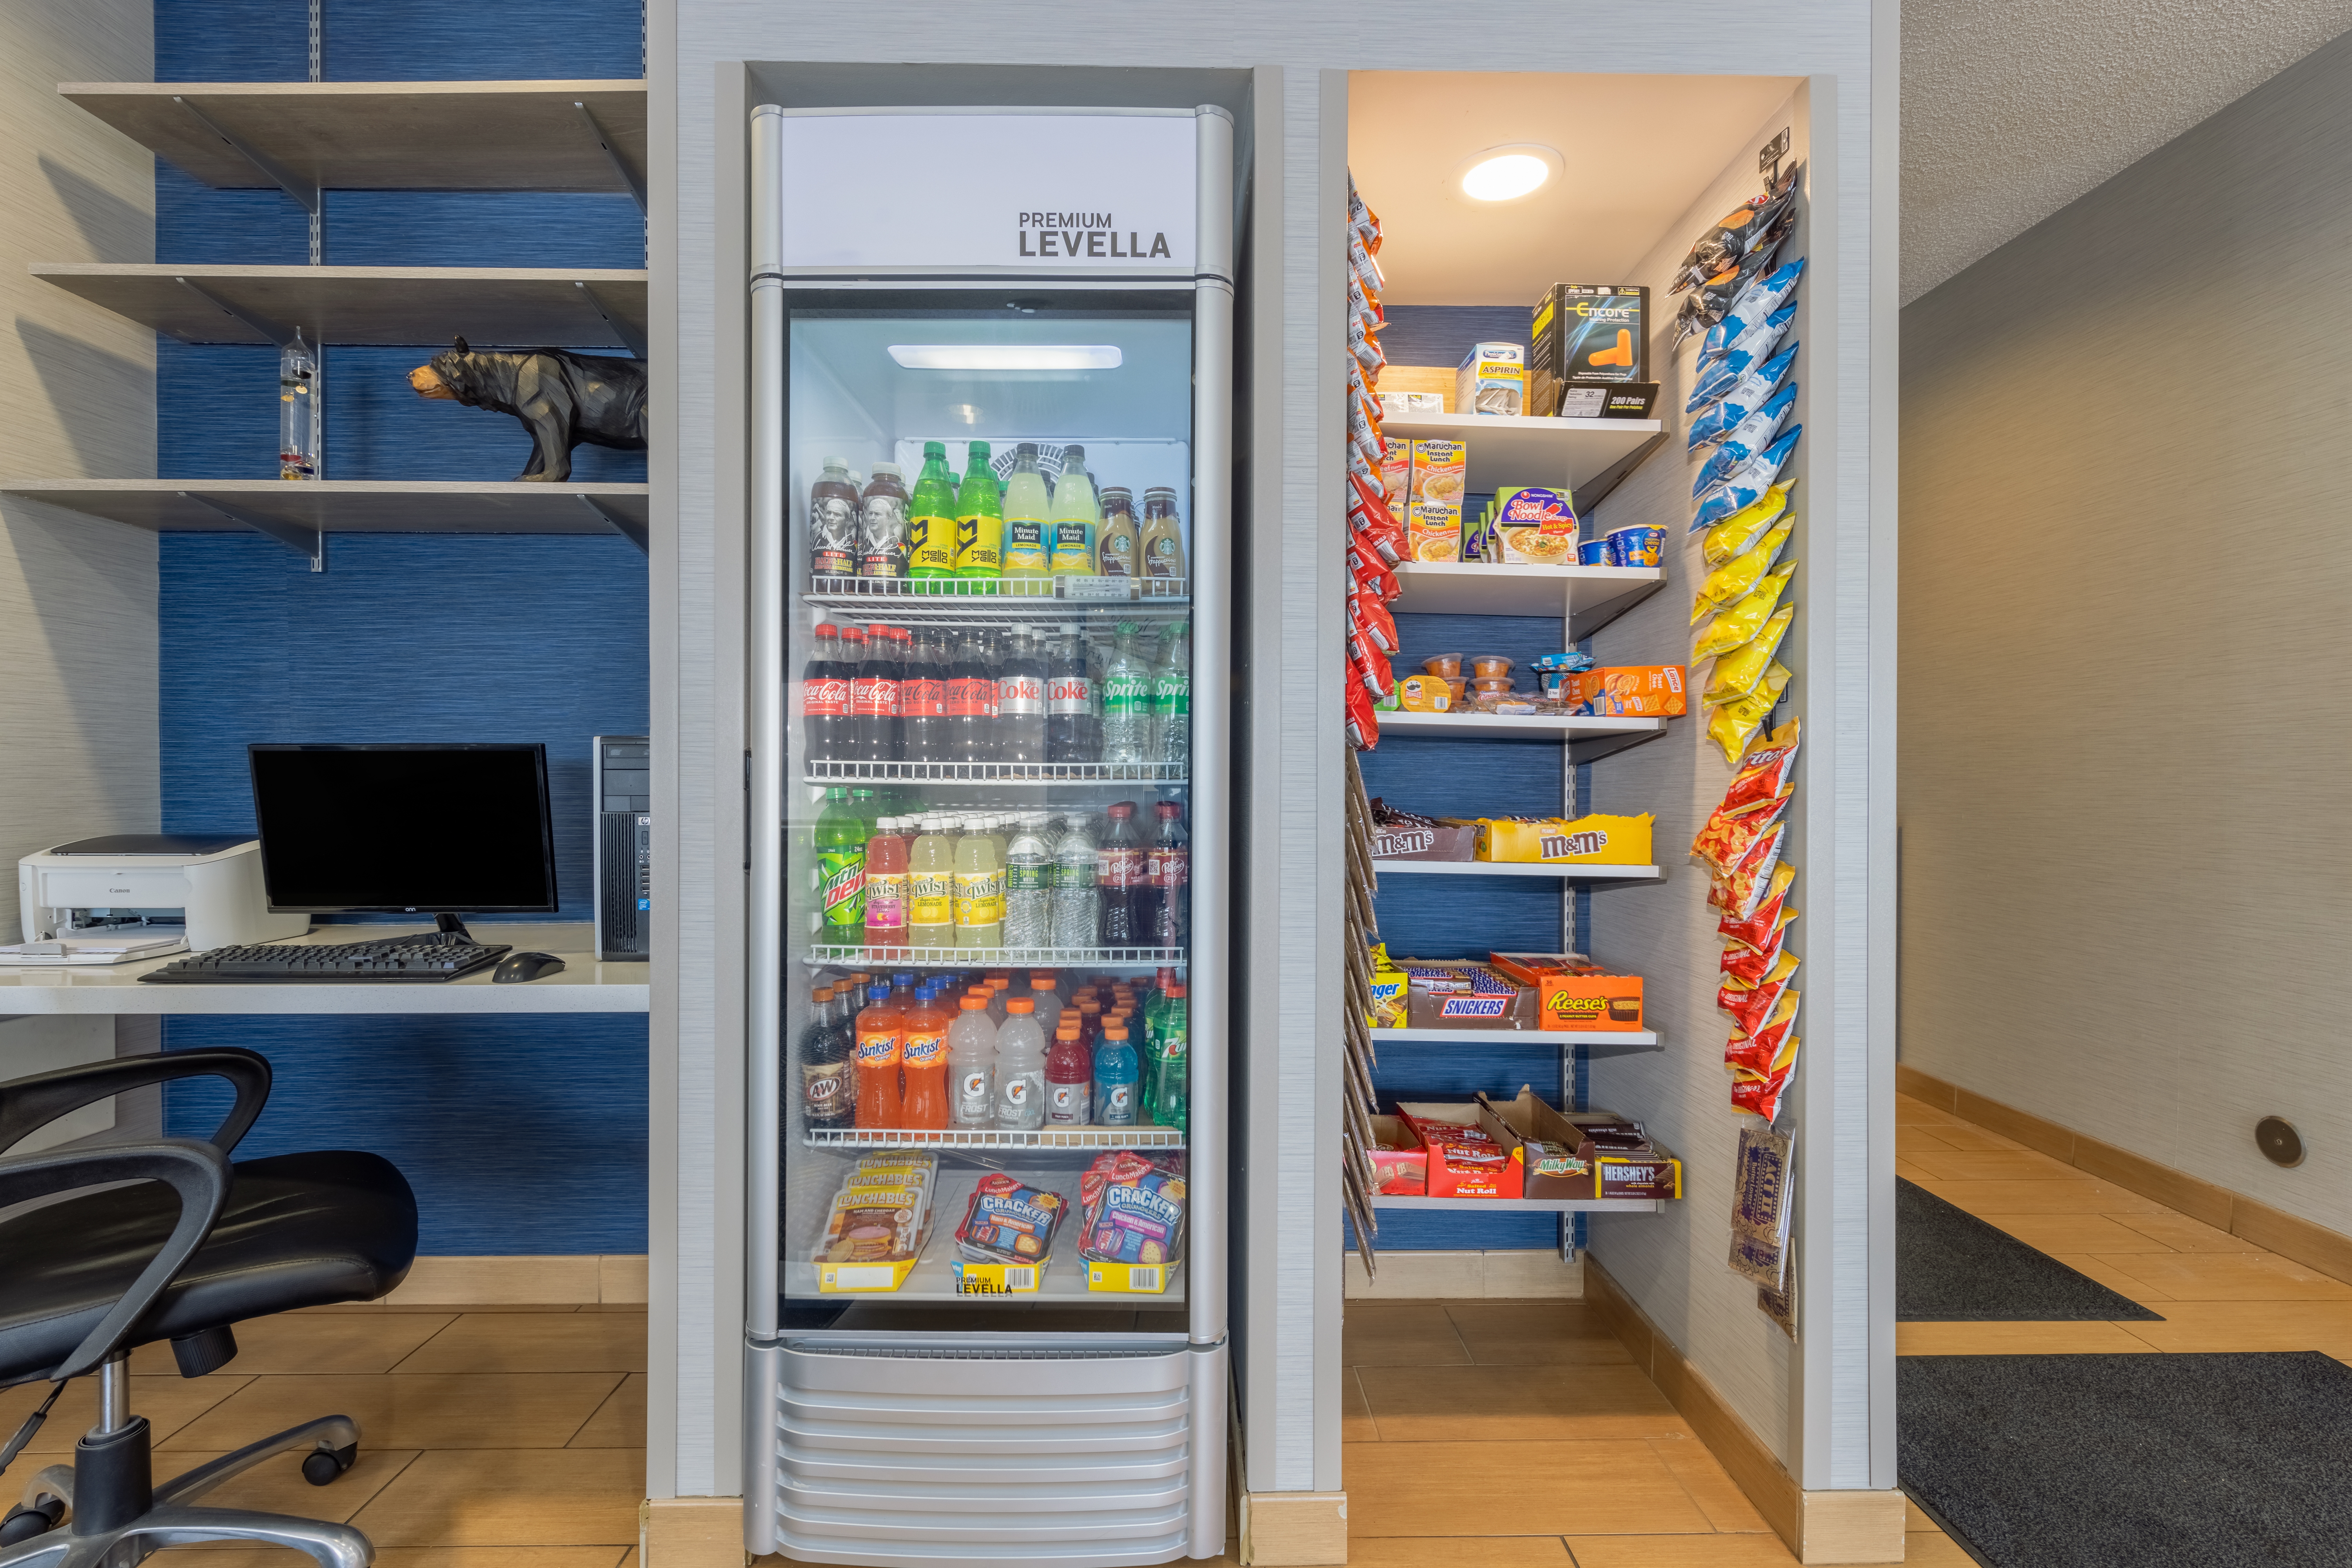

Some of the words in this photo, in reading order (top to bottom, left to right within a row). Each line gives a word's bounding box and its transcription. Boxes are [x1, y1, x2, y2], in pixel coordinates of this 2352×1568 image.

[1020, 212, 1112, 228] PREMIUM
[1020, 231, 1171, 258] LEVELLA
[1576, 302, 1629, 318] Encore
[1483, 366, 1520, 375] ASPIRIN
[1427, 465, 1452, 473] Chicken
[1421, 506, 1458, 515] Maruchan
[1511, 499, 1544, 510] Bowl
[1508, 510, 1551, 521] Noodle
[1422, 528, 1447, 537] Chicken
[1102, 552, 1131, 564] frappuccino
[1147, 555, 1176, 567] frappuccino
[1668, 669, 1679, 691] Lance
[804, 681, 848, 701] Coca-Cola
[854, 681, 898, 701] Coca-Cola
[999, 680, 1040, 700] Coke
[1048, 681, 1088, 701] Coke
[1106, 679, 1148, 700] Sprite
[1540, 830, 1608, 859] m&m's
[866, 883, 902, 901] TWIST
[911, 881, 947, 899] TWIST
[966, 881, 998, 901] TWIST
[1728, 949, 1751, 960] ORIGINAL
[1547, 990, 1608, 1011] Reese's
[1725, 993, 1748, 1003] ORIGINAL
[1445, 1000, 1504, 1014] SNICKERS
[858, 1036, 896, 1059] Sunkist
[904, 1038, 941, 1060] Sunkist
[1732, 1038, 1757, 1050] ORIGINAL
[875, 1053, 891, 1062] Orange
[812, 1078, 835, 1098] A&W
[964, 1071, 985, 1097] G
[1006, 1079, 1026, 1105] G
[1737, 1085, 1761, 1093] ORIGINAL
[1053, 1087, 1069, 1107] G
[1111, 1087, 1128, 1107] G
[960, 1104, 988, 1112] FROST
[998, 1107, 1025, 1117] FROST
[862, 1156, 931, 1169] LUNCHABLES
[1541, 1158, 1565, 1174] Milky
[1566, 1157, 1584, 1171] Way
[1112, 1164, 1150, 1180] LunchMakers
[1605, 1166, 1655, 1181] HERSHEY'S
[1764, 1161, 1777, 1195] ACT
[848, 1174, 922, 1188] LUNCHABLES
[985, 1181, 1022, 1194] LunchMakers
[838, 1192, 915, 1209] LUNCHABLES
[1109, 1187, 1180, 1223] CRACKER
[1761, 1194, 1773, 1215] II
[982, 1196, 1052, 1225] CRACKER
[1007, 1218, 1033, 1230] American
[1112, 1212, 1133, 1224] Chicken
[1138, 1218, 1165, 1234] American
[956, 1284, 1013, 1294] LEVELLA
